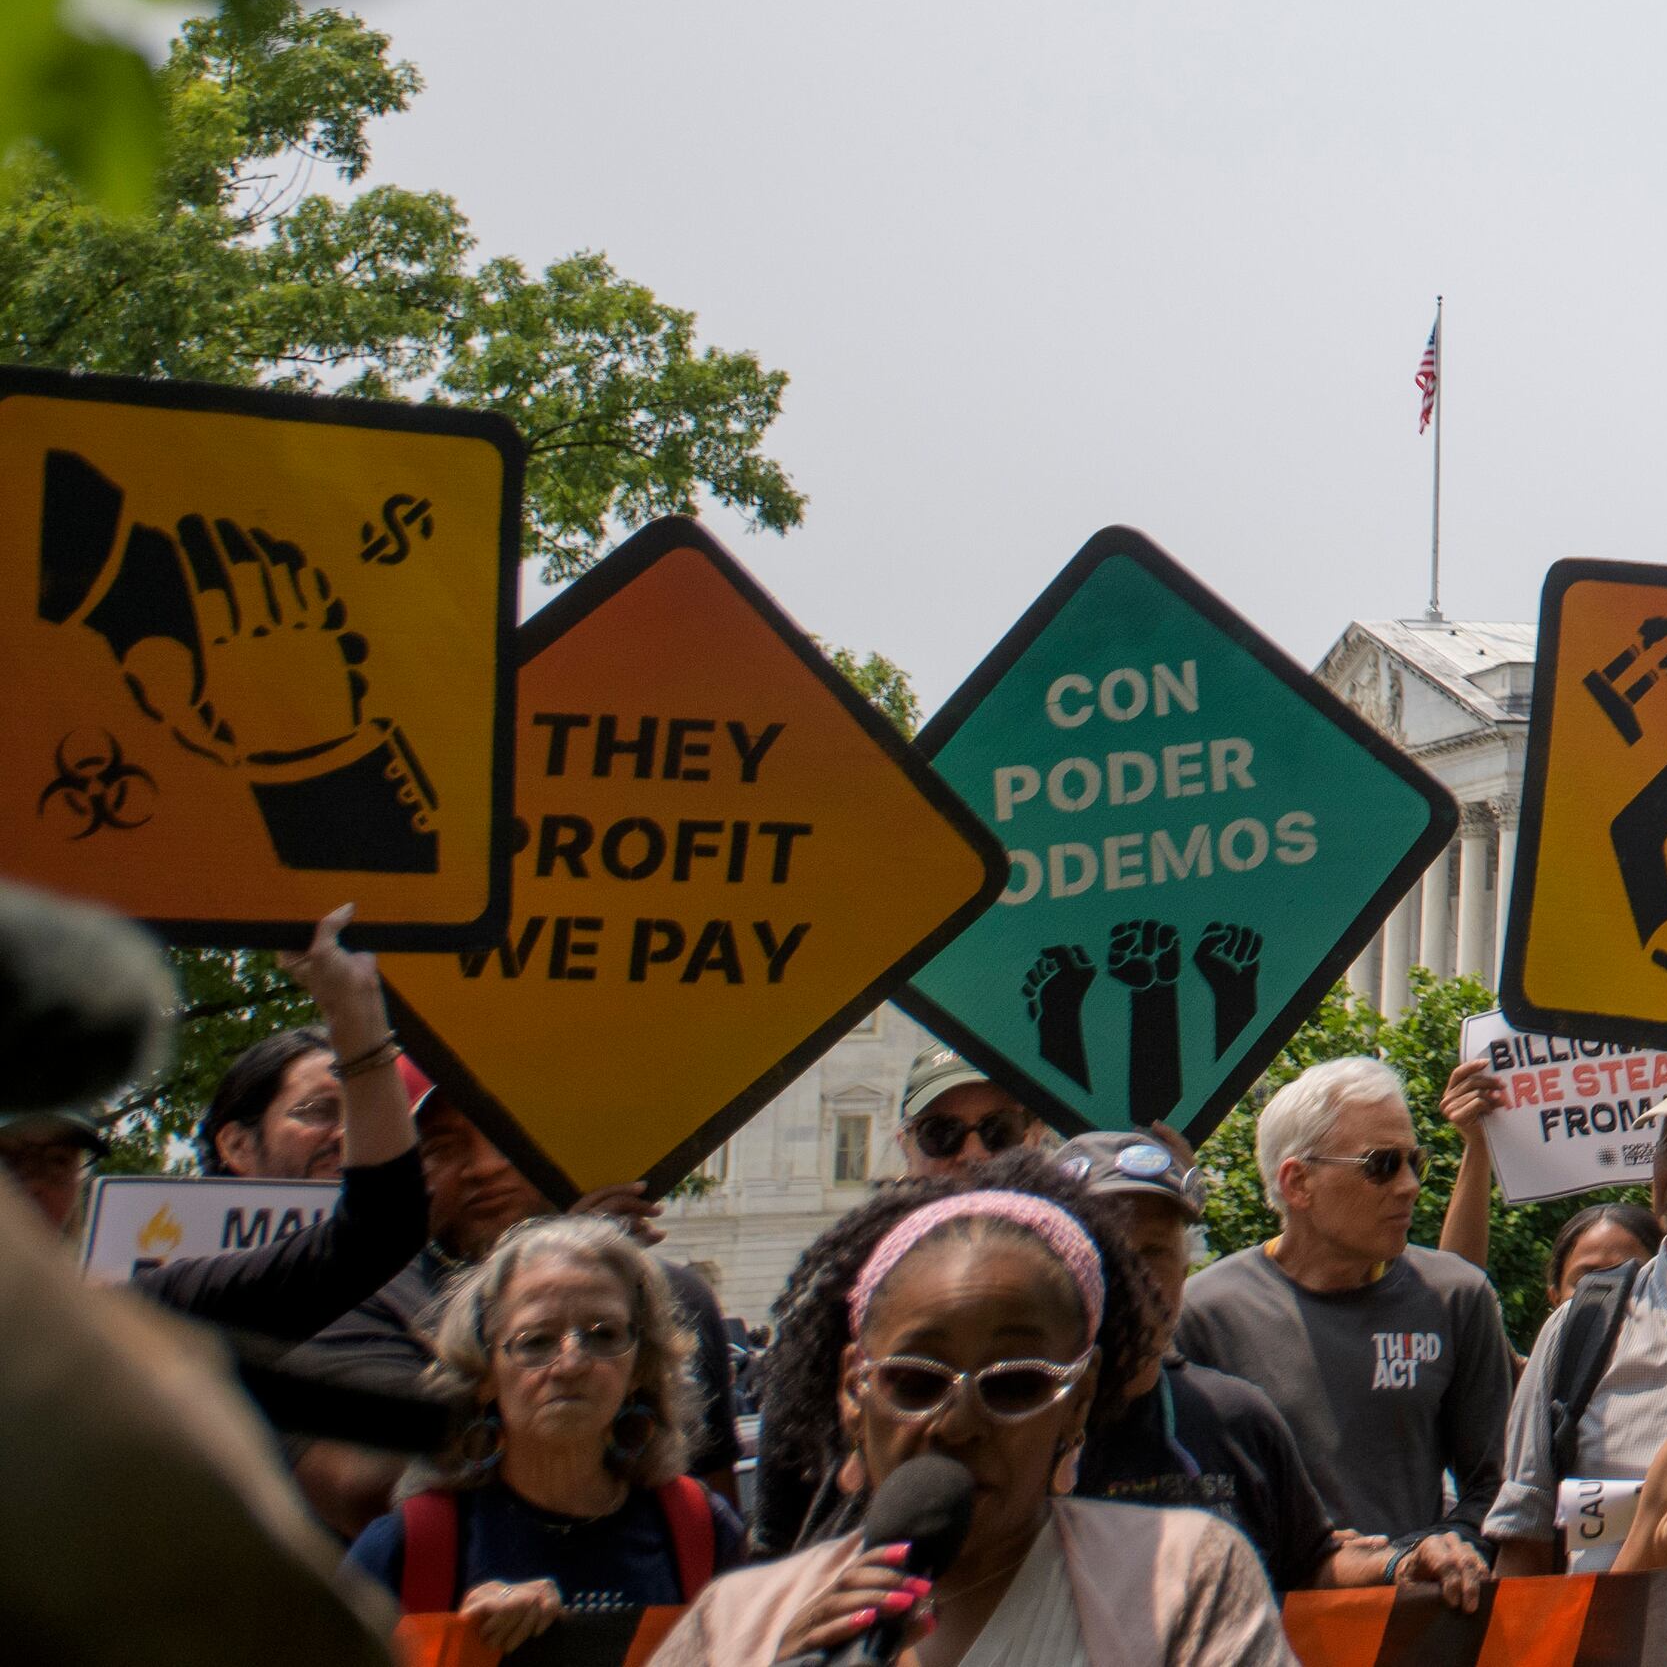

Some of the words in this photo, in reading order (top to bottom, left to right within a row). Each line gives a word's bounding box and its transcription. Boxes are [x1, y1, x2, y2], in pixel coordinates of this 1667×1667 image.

[1045, 659, 1199, 728] CON
[533, 712, 787, 784] THEY
[993, 737, 1256, 822] PODER
[998, 811, 1318, 906] ODEMOS
[628, 917, 812, 984] PAY
[1540, 1096, 1656, 1143] FROM
[1371, 1358, 1418, 1390] ACT
